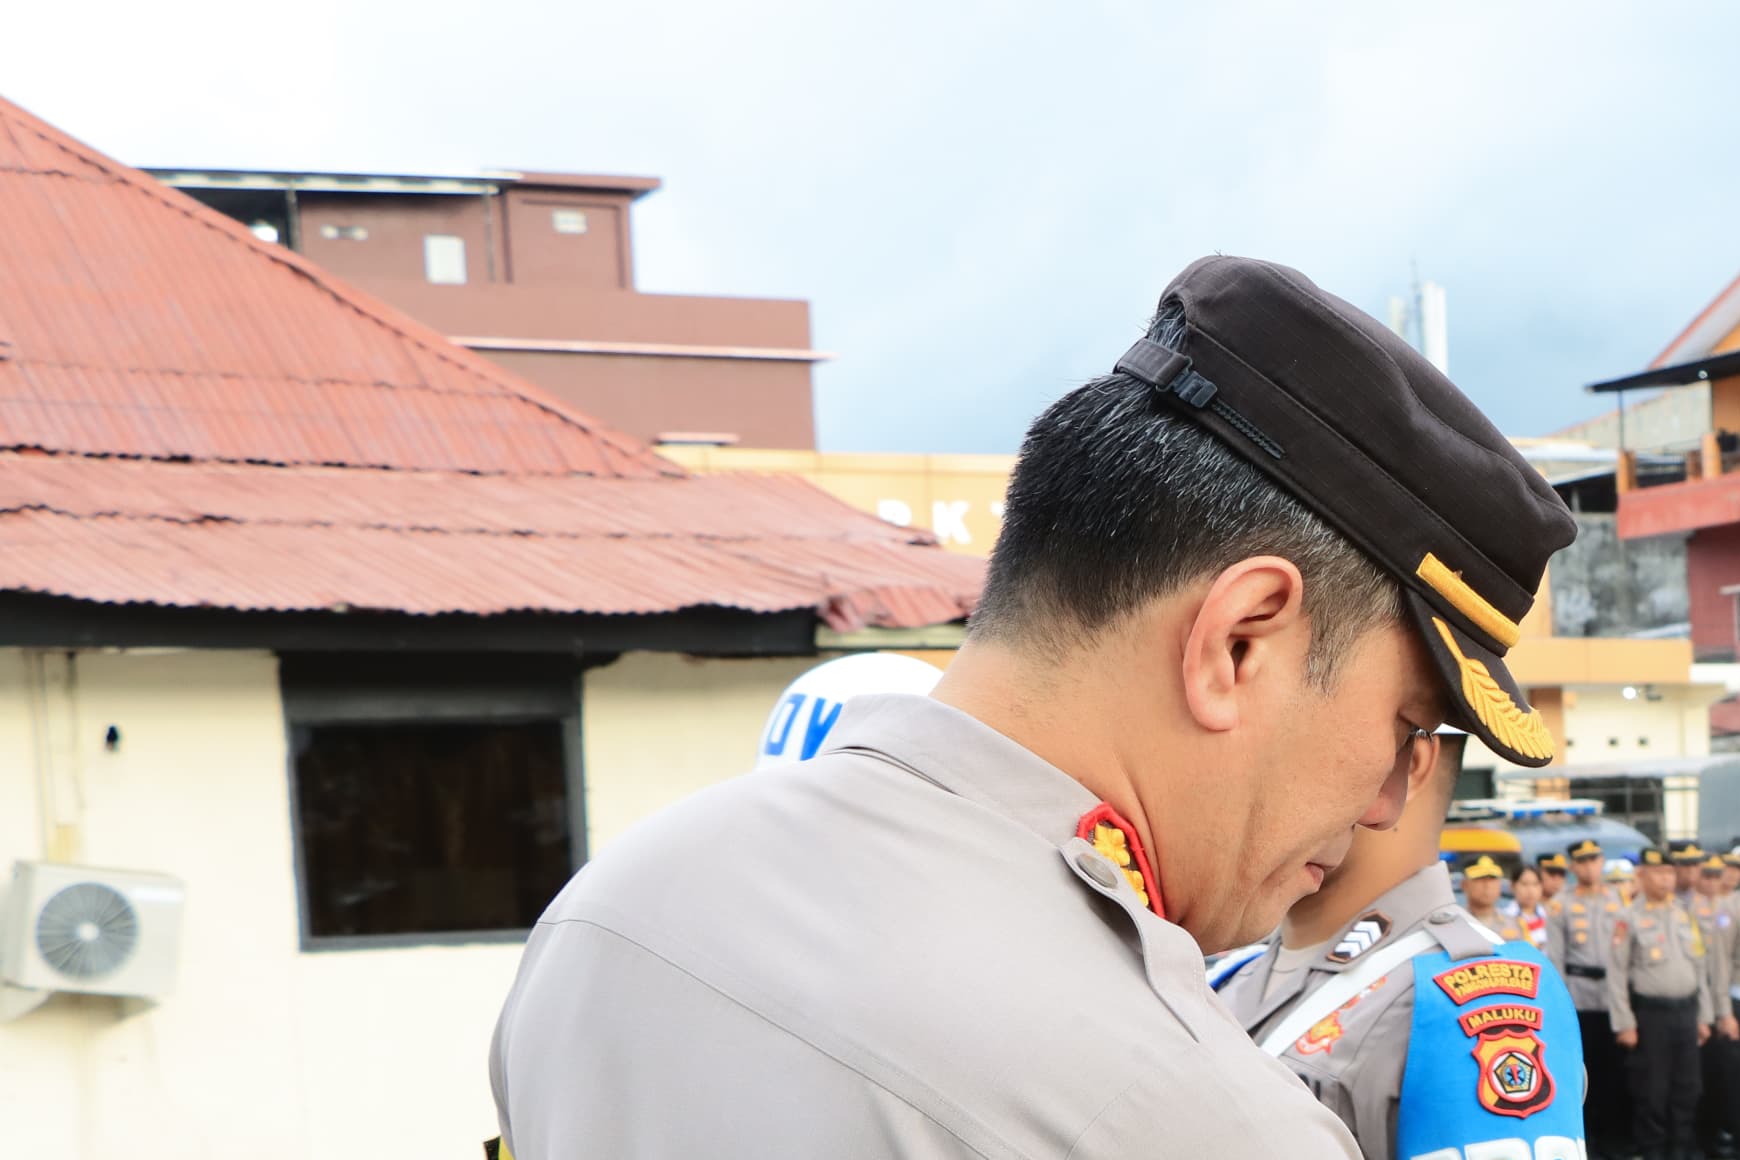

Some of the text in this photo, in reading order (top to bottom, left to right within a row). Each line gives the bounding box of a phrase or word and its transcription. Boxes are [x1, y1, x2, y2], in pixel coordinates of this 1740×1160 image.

[764, 693, 843, 761] OV
[1443, 963, 1534, 989] POLRESTA
[1468, 1008, 1536, 1028] MALUKU
